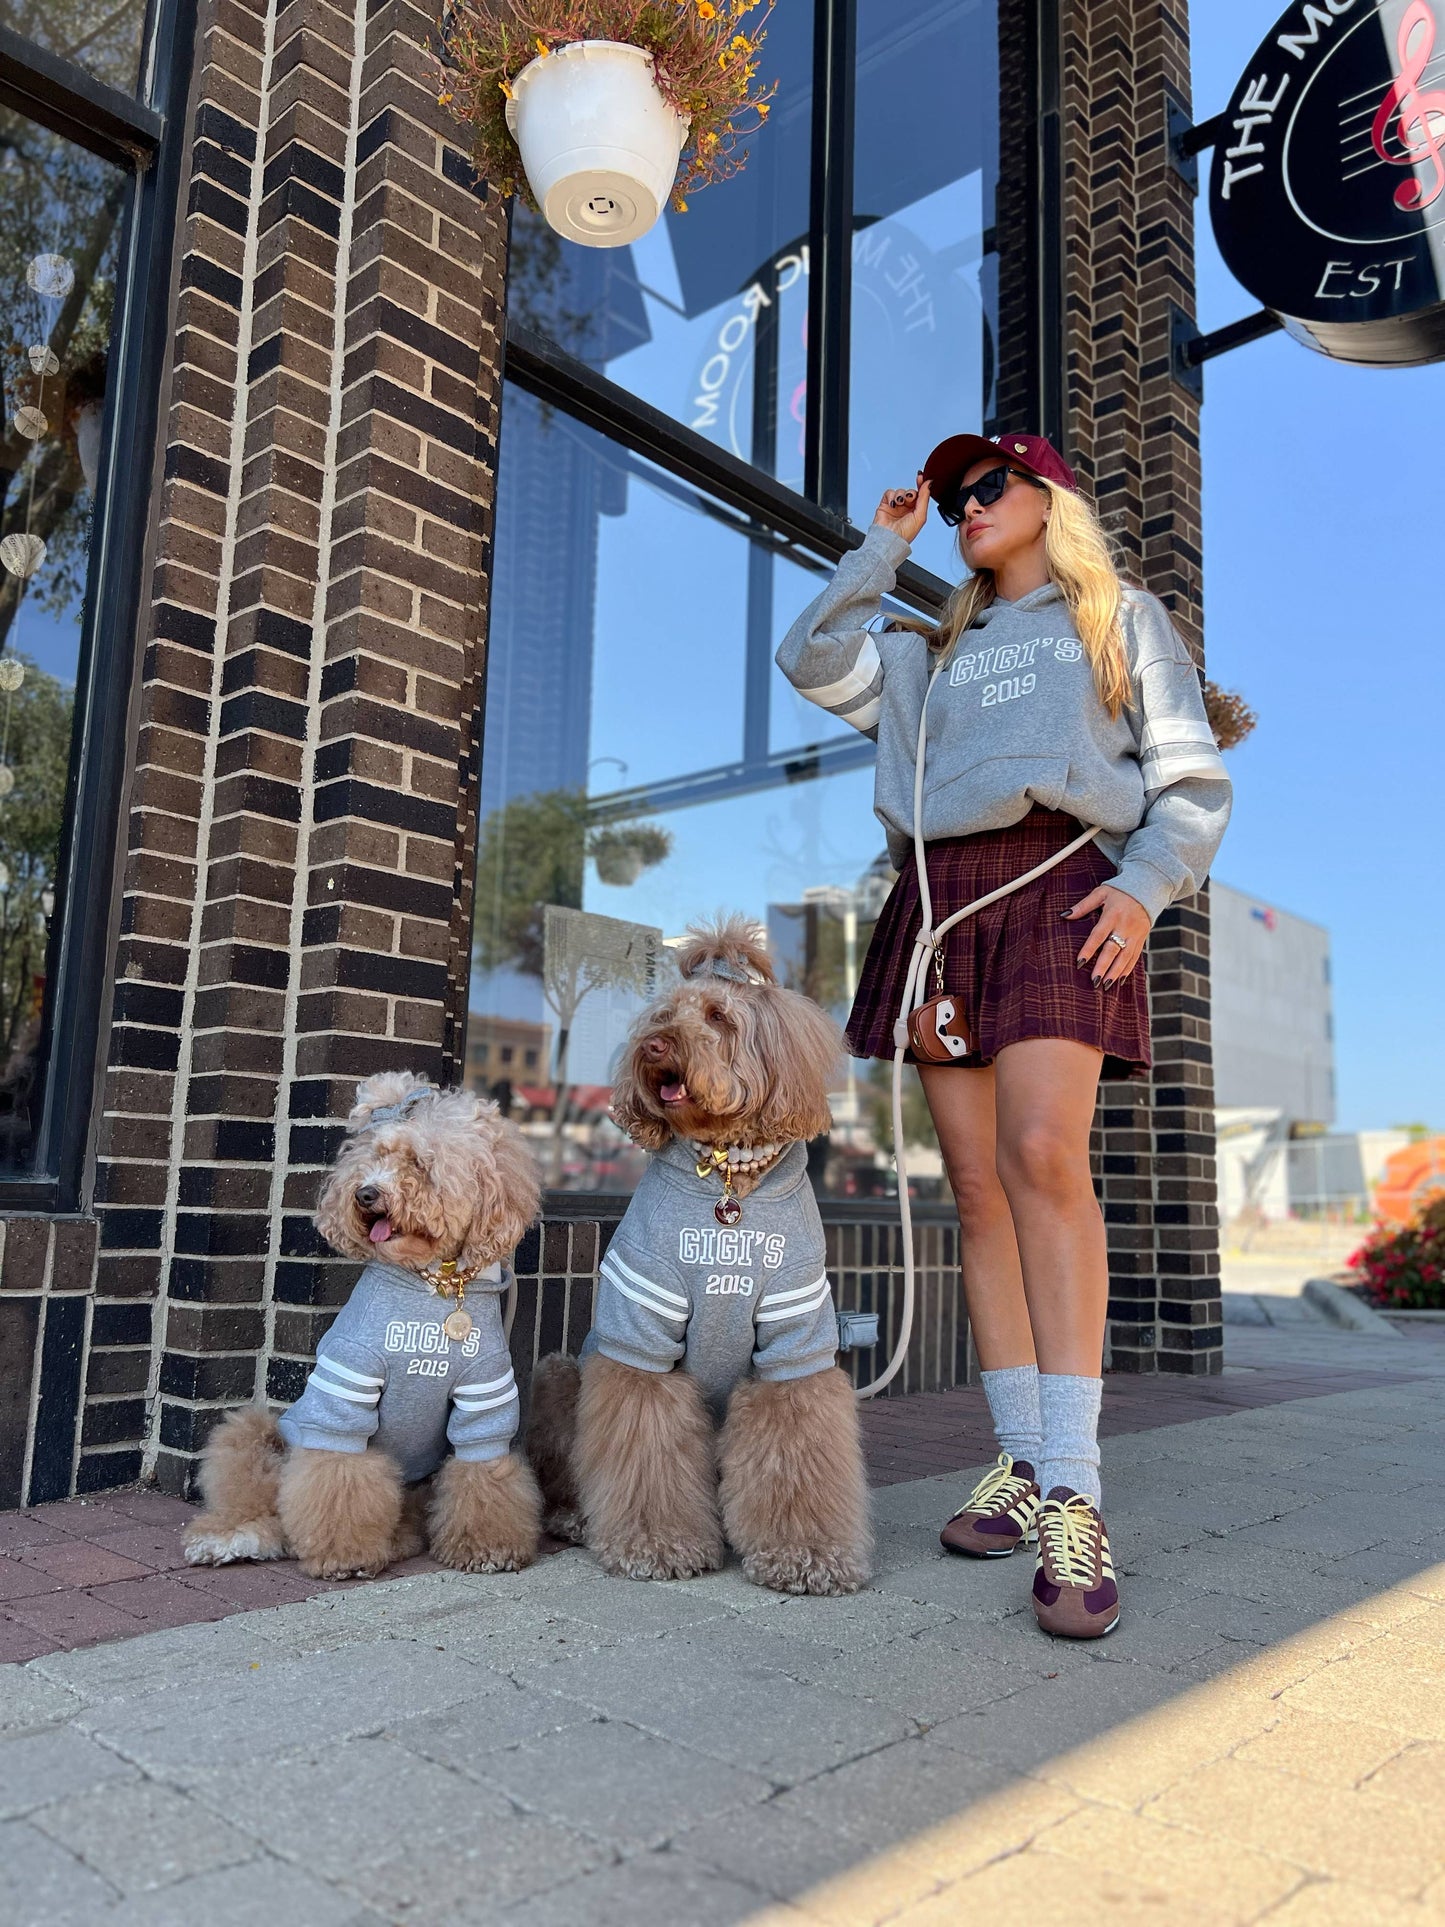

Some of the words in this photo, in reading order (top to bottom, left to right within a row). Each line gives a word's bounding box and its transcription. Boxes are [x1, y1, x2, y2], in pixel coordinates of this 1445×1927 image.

[1221, 73, 1290, 199] THE
[1315, 256, 1416, 299] EST
[950, 637, 1083, 687] GIGI'S
[981, 673, 1037, 708] 2019
[679, 1228, 786, 1269] GIGI'S
[705, 1274, 754, 1297] 2019
[384, 1321, 481, 1358] GIGIS
[406, 1359, 450, 1377] 2019
